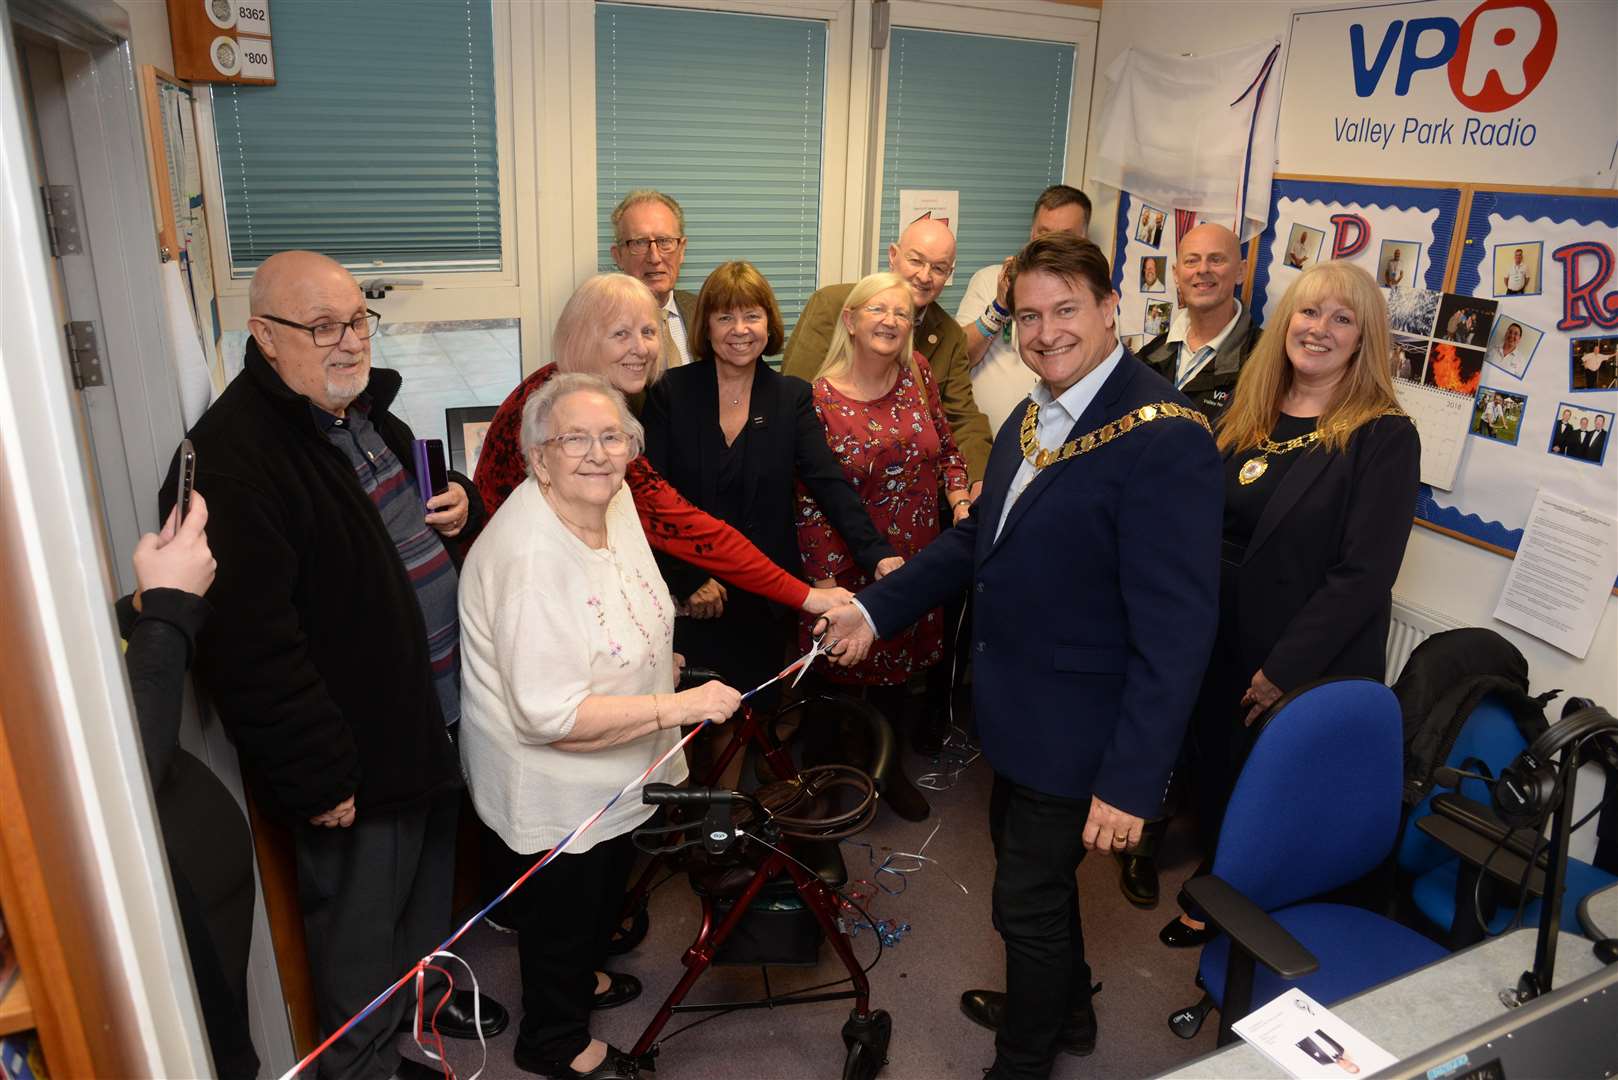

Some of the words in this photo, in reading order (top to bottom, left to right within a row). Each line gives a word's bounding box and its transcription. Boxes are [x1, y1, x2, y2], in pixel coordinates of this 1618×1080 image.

[239, 6, 265, 21] 8362
[1349, 5, 1542, 98] VPR
[1334, 117, 1396, 150] Valley
[1401, 117, 1455, 146] Park
[1461, 117, 1537, 147] Radio
